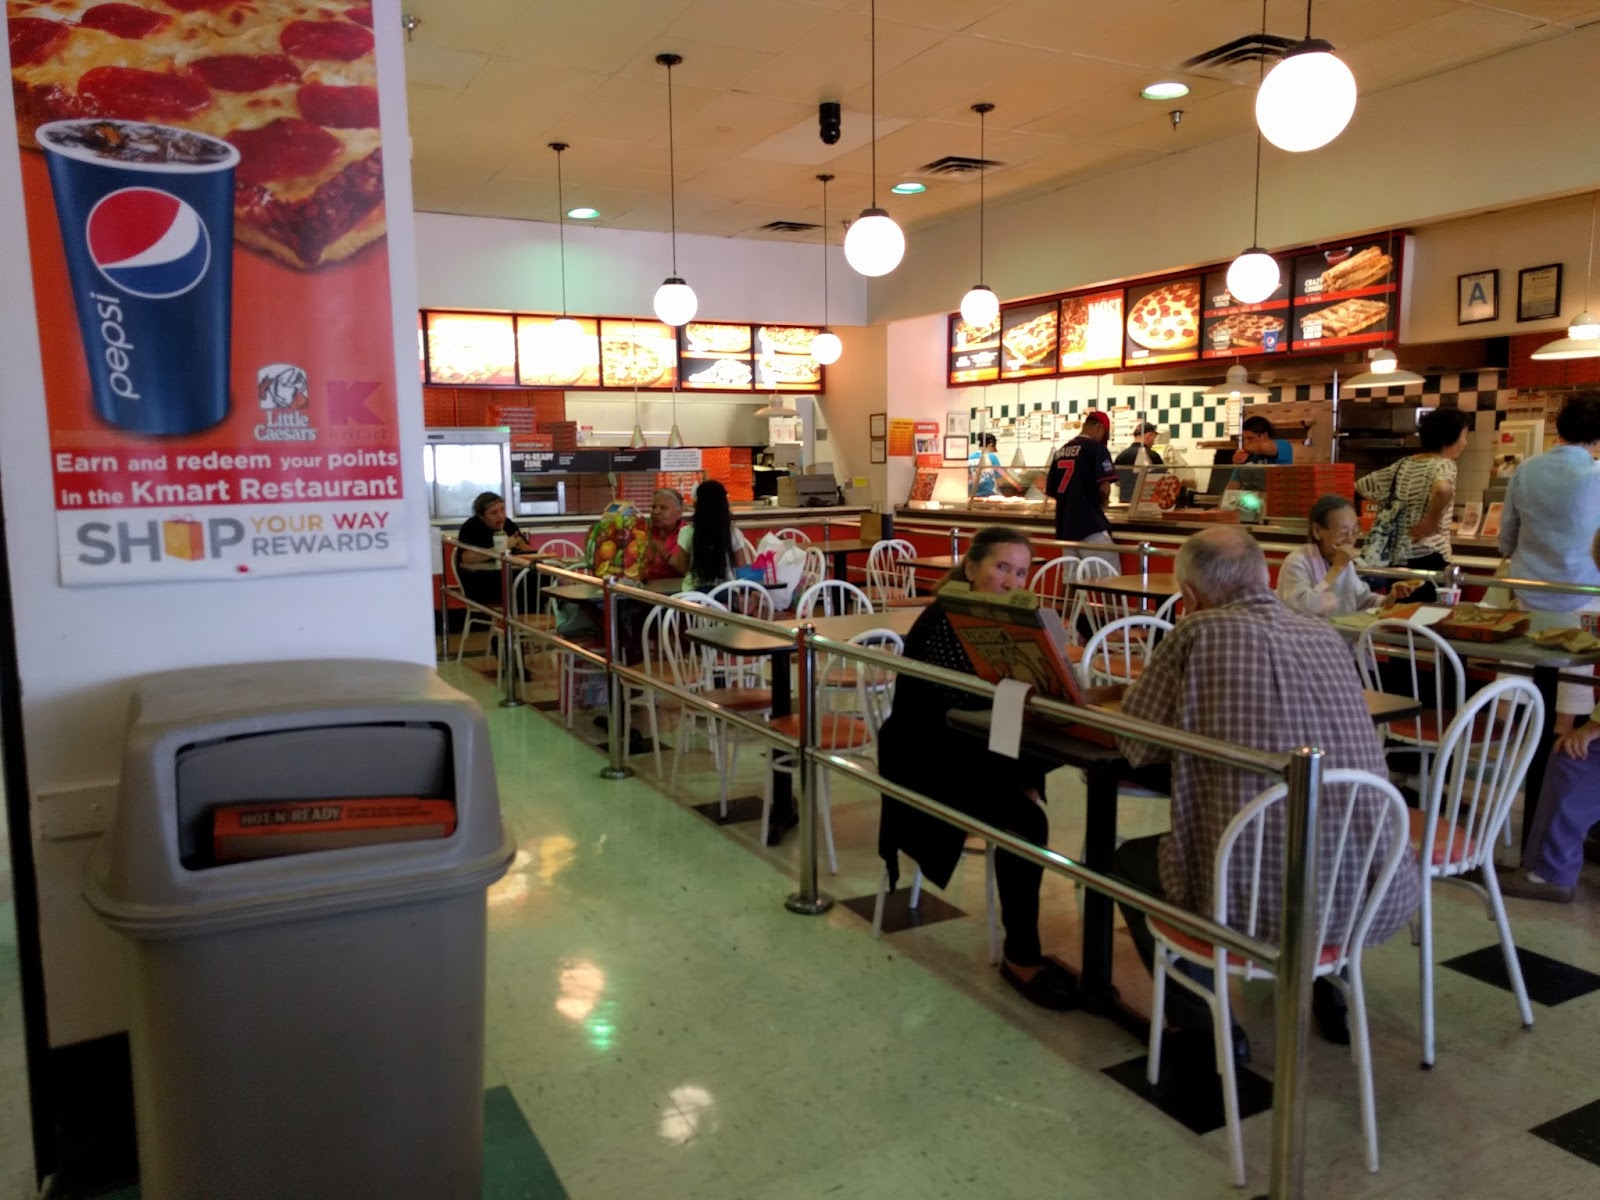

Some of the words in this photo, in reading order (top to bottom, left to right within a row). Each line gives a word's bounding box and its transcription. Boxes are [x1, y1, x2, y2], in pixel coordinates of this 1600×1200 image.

[1468, 281, 1488, 307] A
[90, 290, 141, 400] pepsi
[266, 410, 309, 428] Little
[253, 424, 318, 441] Caesars
[56, 453, 119, 473] Earn
[128, 455, 168, 472] and
[176, 450, 272, 470] redeem
[280, 456, 323, 471] your
[328, 449, 398, 470] points
[1057, 458, 1075, 494] 7
[61, 489, 83, 506] in
[88, 489, 125, 504] the
[131, 479, 231, 504] Kmart
[240, 475, 398, 500] Restaurant
[251, 513, 324, 535] YOUR
[332, 511, 390, 531] WAY
[252, 531, 390, 557] REWARDS
